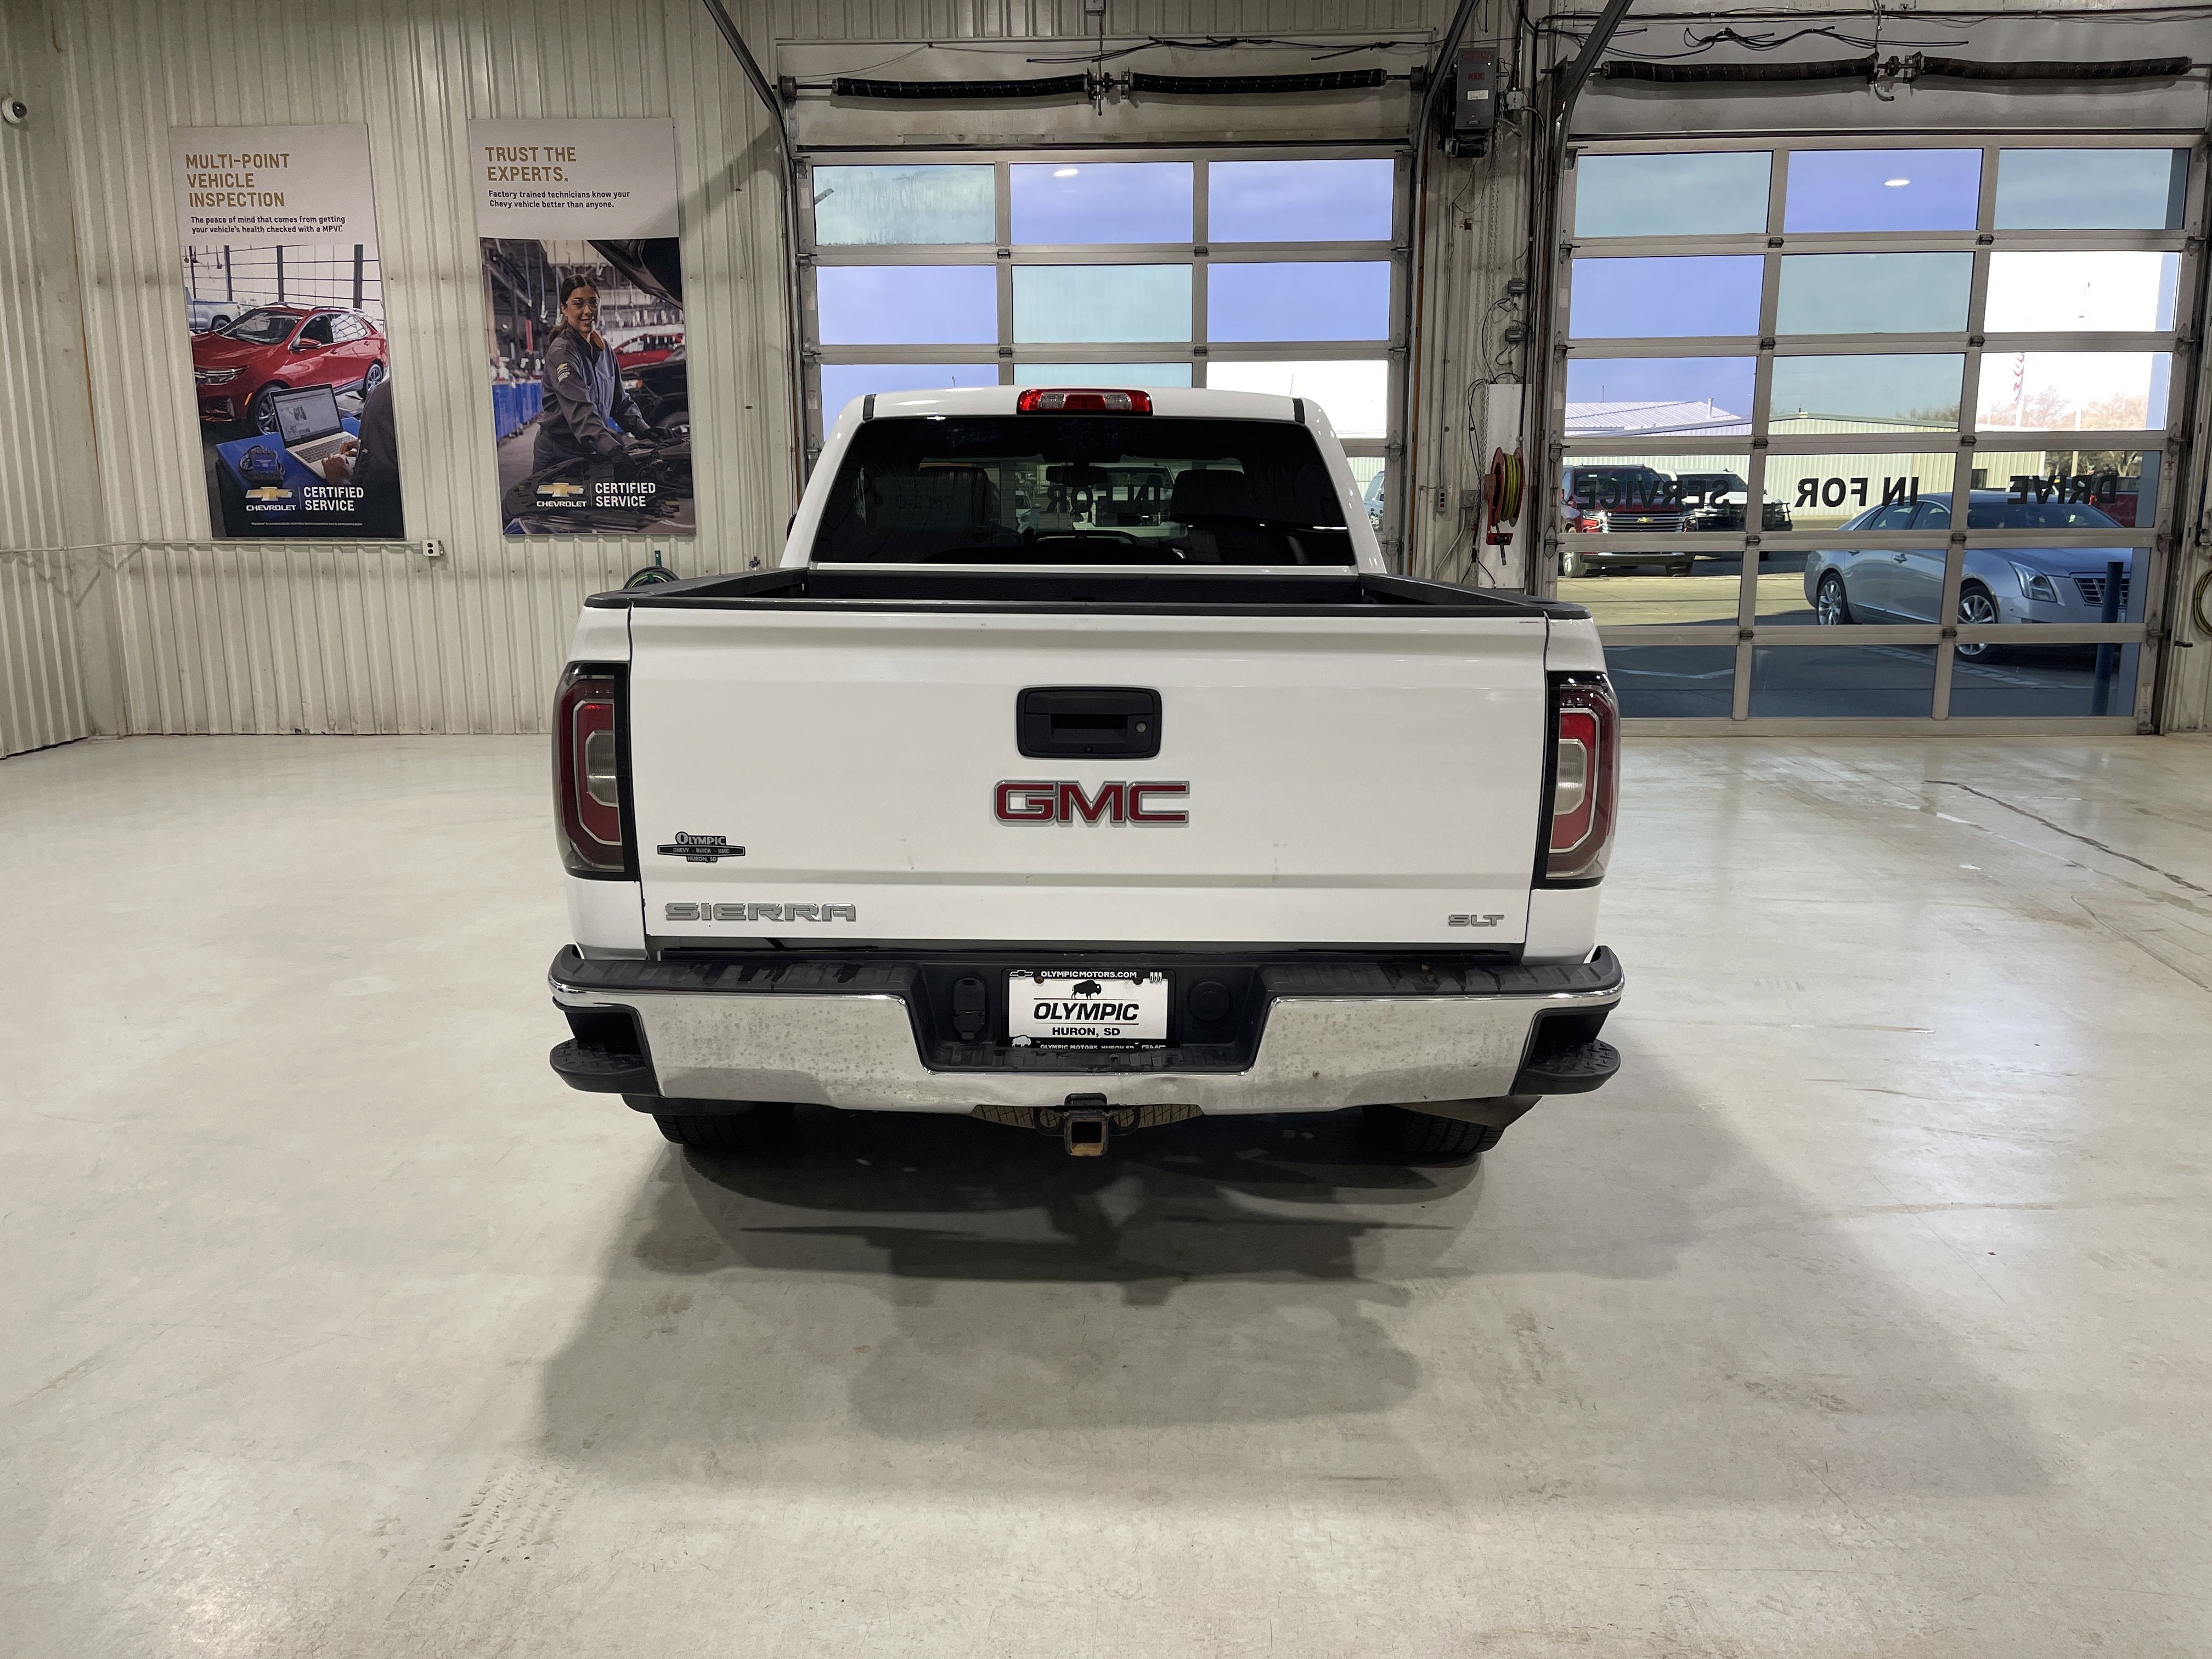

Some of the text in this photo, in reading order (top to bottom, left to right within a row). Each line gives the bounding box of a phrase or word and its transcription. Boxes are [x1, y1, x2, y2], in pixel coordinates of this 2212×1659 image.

[185, 153, 290, 168] MULTI-POINT
[485, 146, 577, 162] TRUST THE
[187, 173, 255, 188] VEHICLE
[487, 166, 568, 182] EXPERTS.
[189, 192, 285, 207] INSPECTION
[489, 190, 517, 199] Factory
[490, 200, 512, 208] Chevy
[319, 216, 345, 224] getting
[303, 487, 364, 498] CERTIFIED
[595, 483, 655, 494] CERTIFIED
[305, 500, 355, 511] SERVICE
[596, 496, 646, 507] SERVICE
[994, 780, 1190, 825] GMC
[676, 832, 726, 845] OLYMPIC
[665, 902, 856, 922] SIERRA
[1448, 914, 1505, 927] SLT
[1034, 1002, 1139, 1020] OLYMPIC
[1052, 1028, 1120, 1037] HURON, SD
